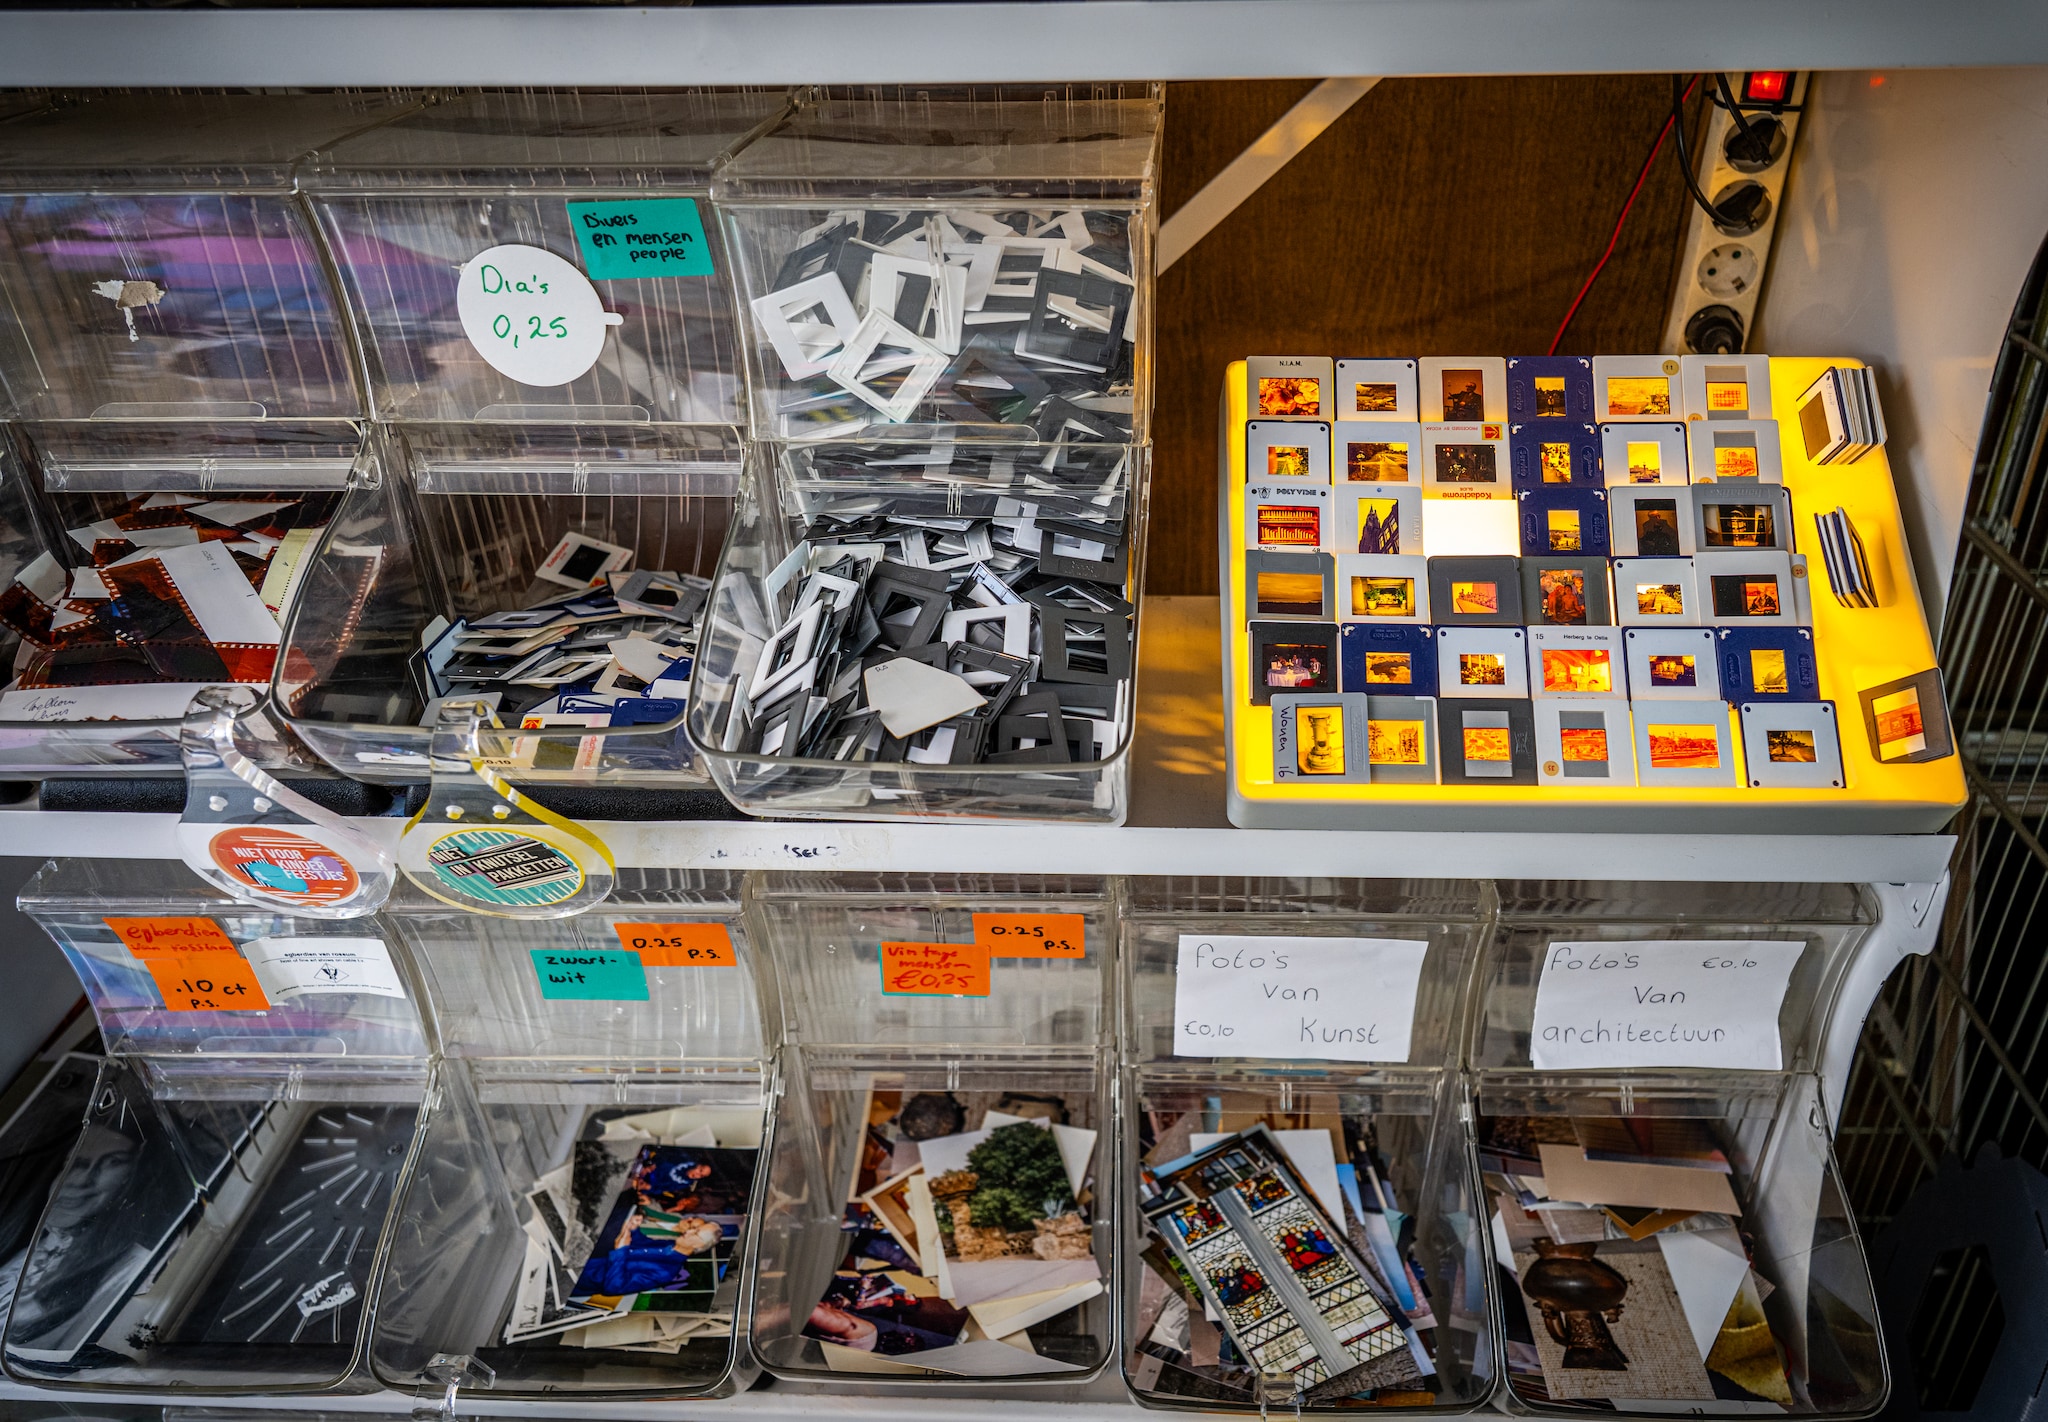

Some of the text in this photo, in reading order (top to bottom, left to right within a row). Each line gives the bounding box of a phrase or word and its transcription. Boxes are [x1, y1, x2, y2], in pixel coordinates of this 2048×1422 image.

[592, 232, 693, 248] en mensen
[629, 248, 686, 262] people
[481, 264, 549, 294] Dia's
[493, 314, 568, 349] 0,25
[1442, 492, 1492, 500] Kodachrome
[1278, 706, 1294, 778] Wonen 16
[232, 847, 305, 860] NIET VOOR
[431, 848, 467, 863] NIET
[275, 859, 327, 871] KINDER
[450, 850, 539, 877] IN KNUTSEL
[487, 856, 569, 882] PAKKETTEN
[282, 869, 348, 882] FEESTJES
[991, 926, 1044, 938] 0.25
[632, 937, 683, 949] 0.25
[548, 972, 586, 984] wit
[891, 970, 976, 990] €0,25
[223, 983, 247, 996] ct
[1184, 1016, 1380, 1044] €0,10 Kunst
[1542, 1019, 1726, 1044] architectuur
